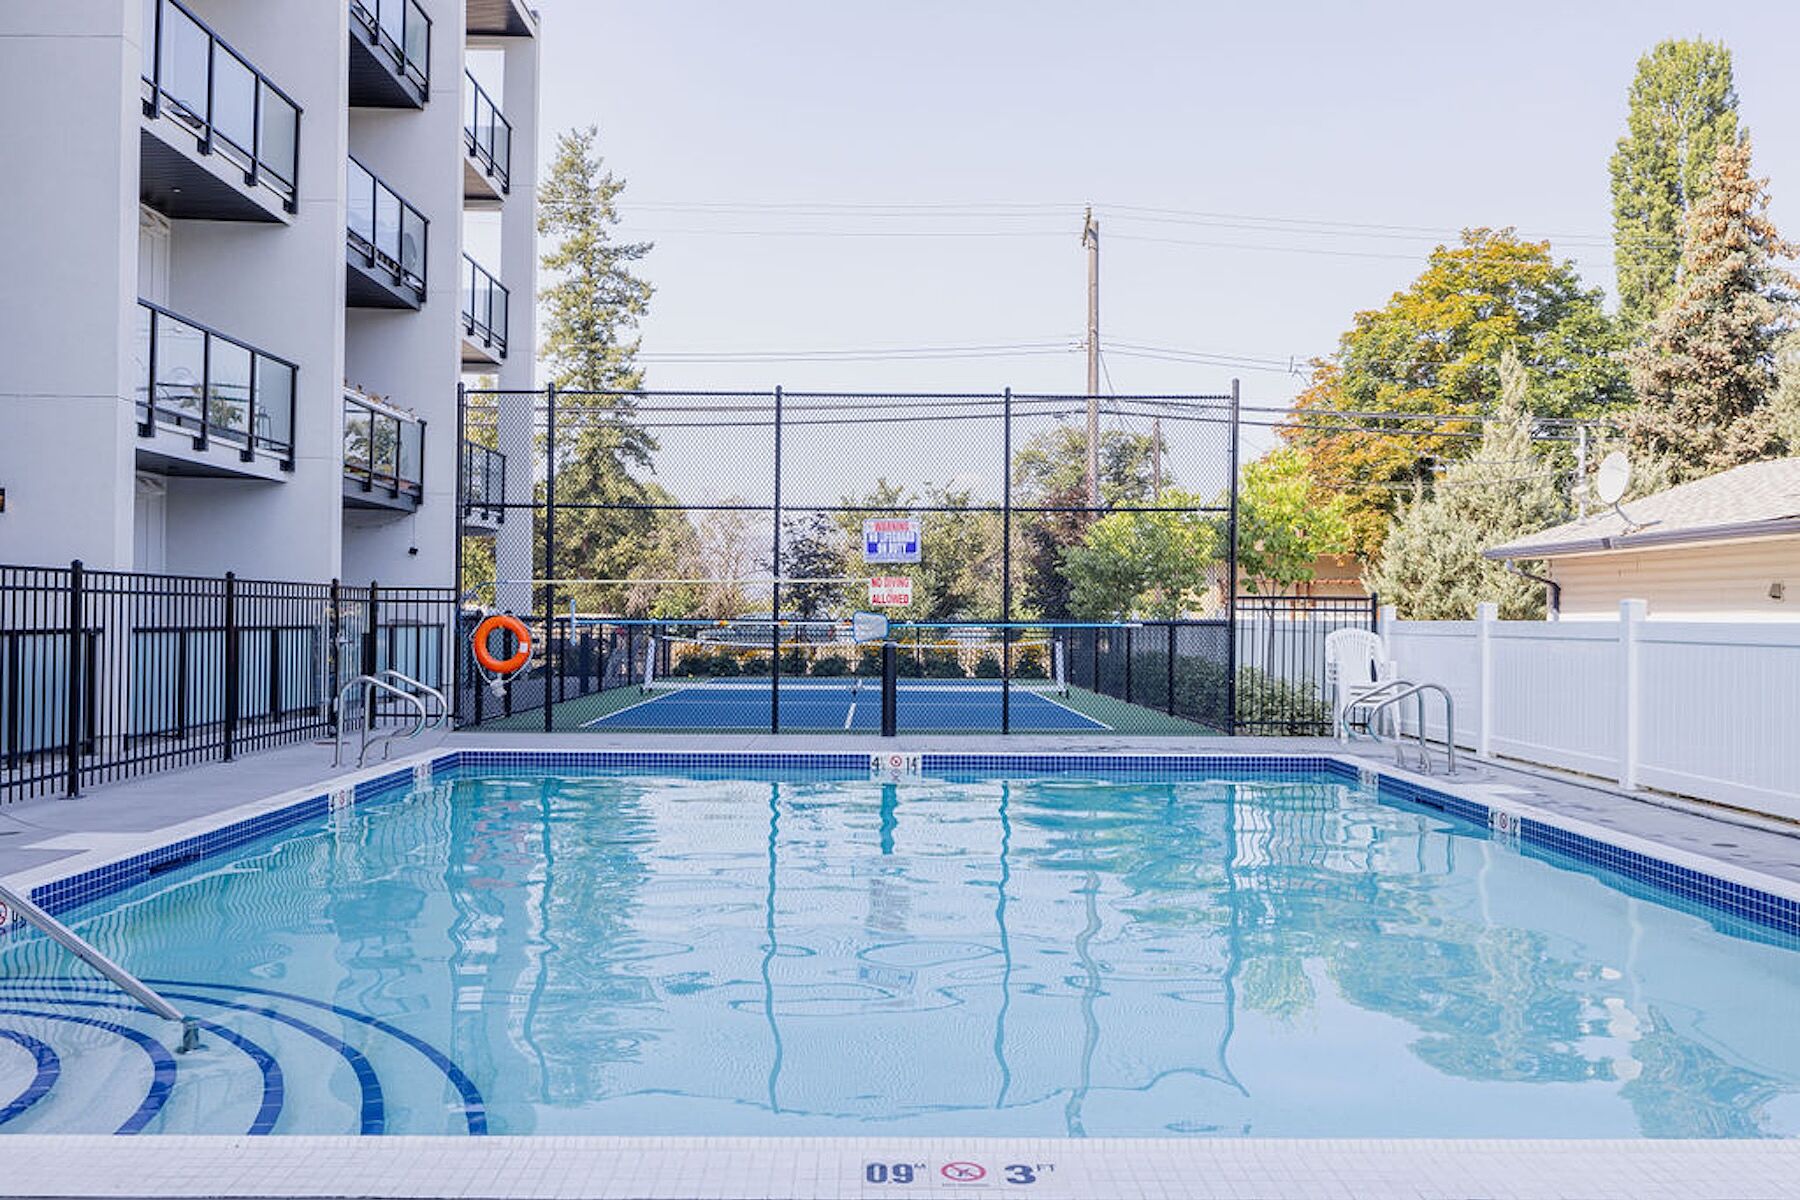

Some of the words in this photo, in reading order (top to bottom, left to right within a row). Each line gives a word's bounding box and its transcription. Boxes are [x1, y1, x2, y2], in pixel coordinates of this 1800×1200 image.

[871, 577, 882, 588] NO
[884, 577, 910, 588] DIVING
[872, 593, 909, 604] ALLOWED
